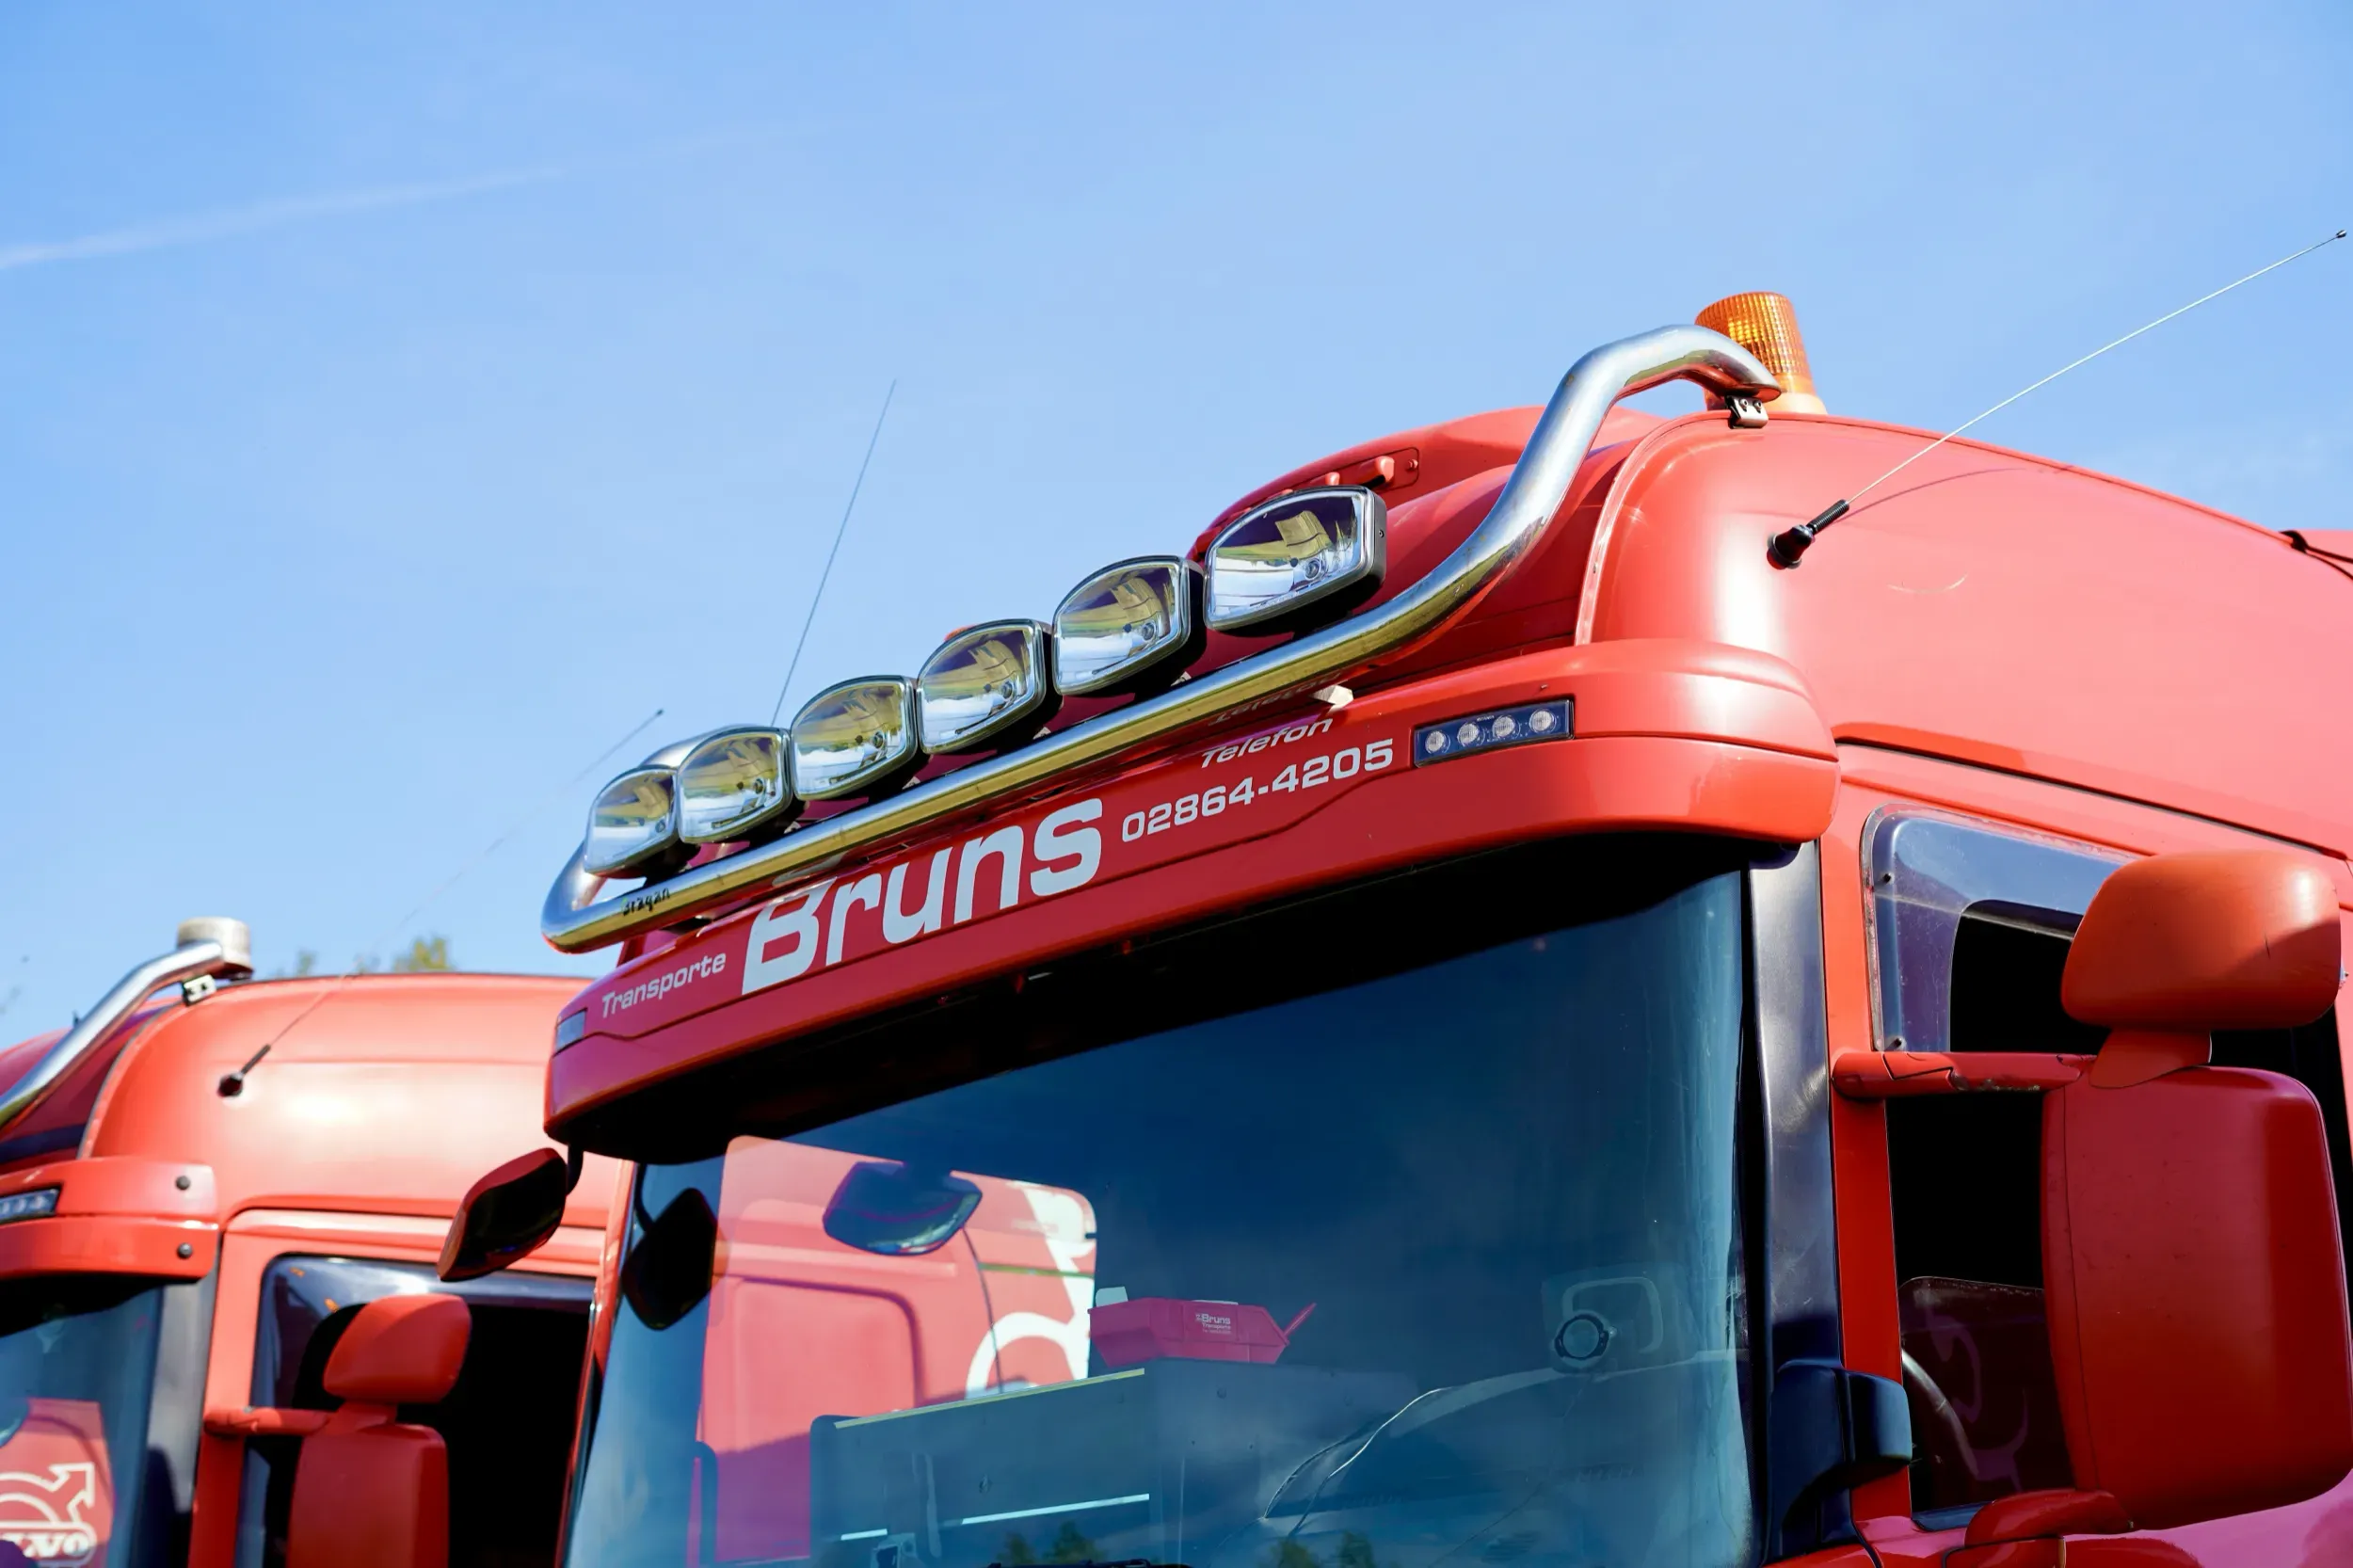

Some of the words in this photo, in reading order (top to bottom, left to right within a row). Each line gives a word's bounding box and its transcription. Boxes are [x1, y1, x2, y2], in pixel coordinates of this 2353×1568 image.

[1121, 738, 1393, 842] 02864-4205
[1201, 718, 1333, 768] Telefon
[602, 952, 727, 1018] Transporte
[742, 798, 1103, 996] Bruns
